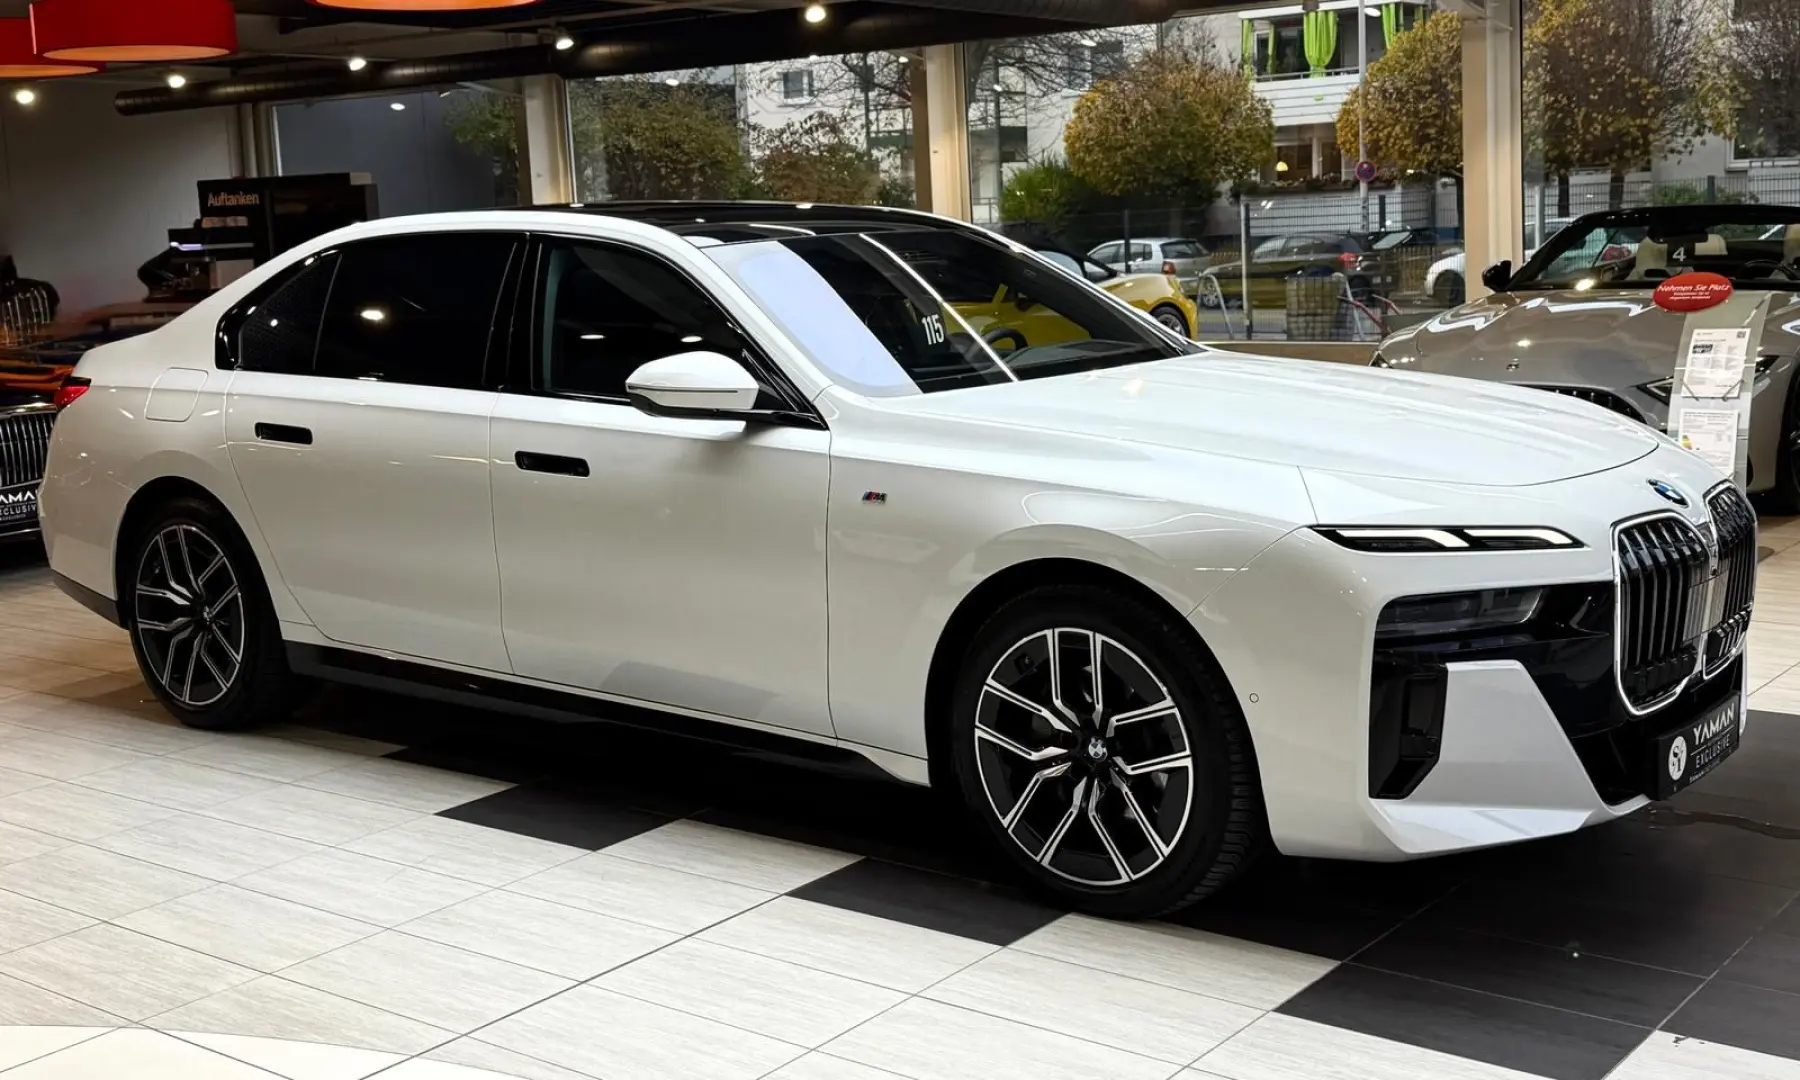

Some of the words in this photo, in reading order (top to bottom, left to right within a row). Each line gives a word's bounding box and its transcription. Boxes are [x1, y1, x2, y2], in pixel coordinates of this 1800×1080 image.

[207, 191, 260, 207] Auftanken
[1672, 246, 1687, 262] 4
[1657, 284, 1693, 292] Nehmen
[921, 314, 945, 345] 115
[0, 490, 38, 504] AMA
[1693, 702, 1735, 745] YAMAN
